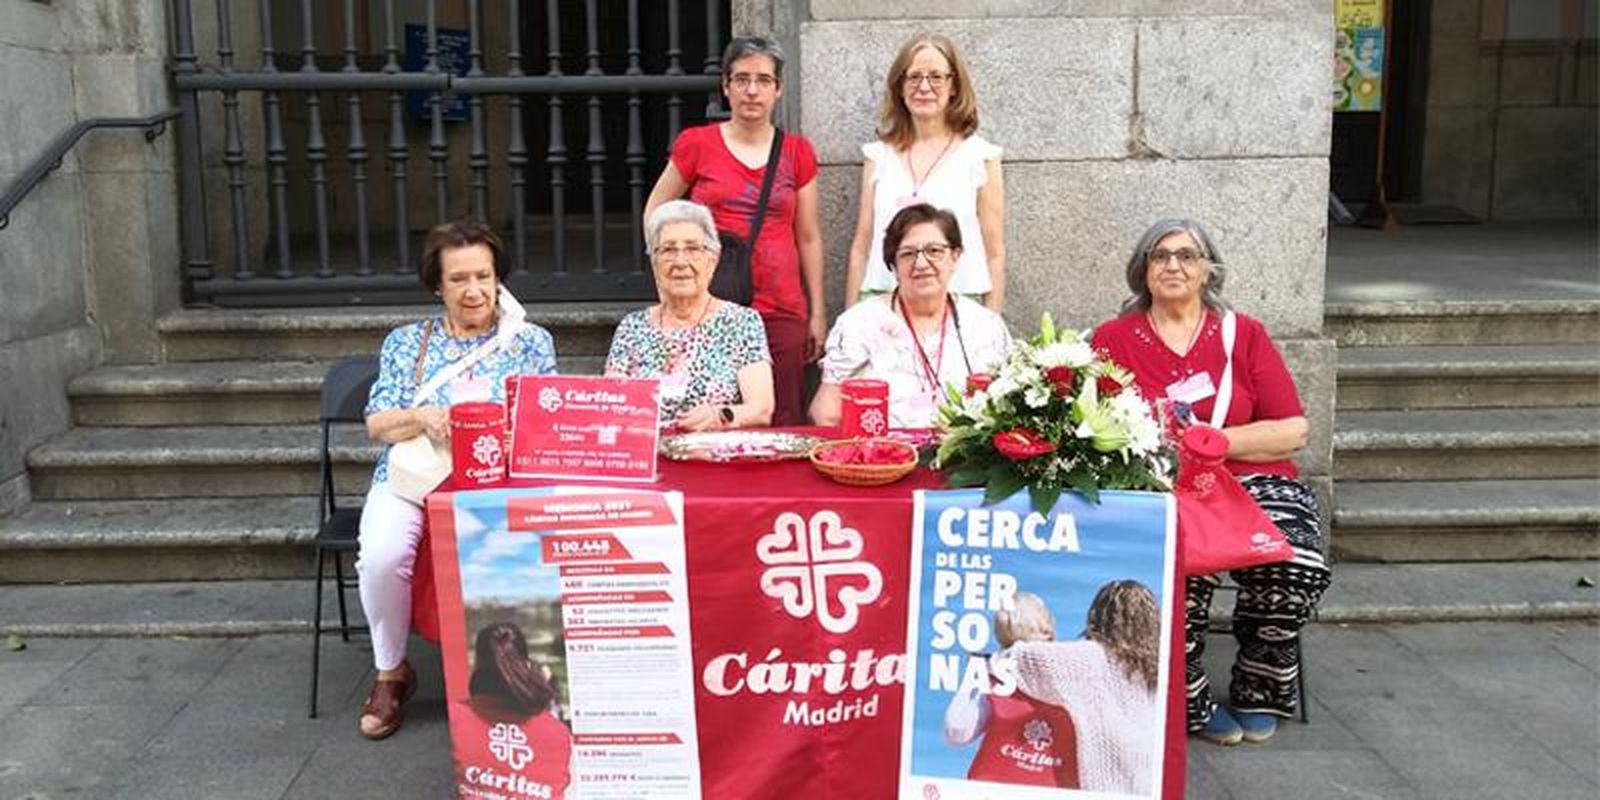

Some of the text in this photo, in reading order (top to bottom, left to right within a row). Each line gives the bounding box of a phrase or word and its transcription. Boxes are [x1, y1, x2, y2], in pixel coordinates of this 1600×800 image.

[937, 507, 1081, 553] CERCA
[936, 552, 992, 569] DE LAS
[933, 570, 1018, 611] PER
[931, 611, 990, 653] SO
[703, 648, 908, 696] Cárita
[929, 653, 1018, 697] NAS
[784, 694, 880, 726] Madrid
[465, 766, 552, 799] Cáritas
